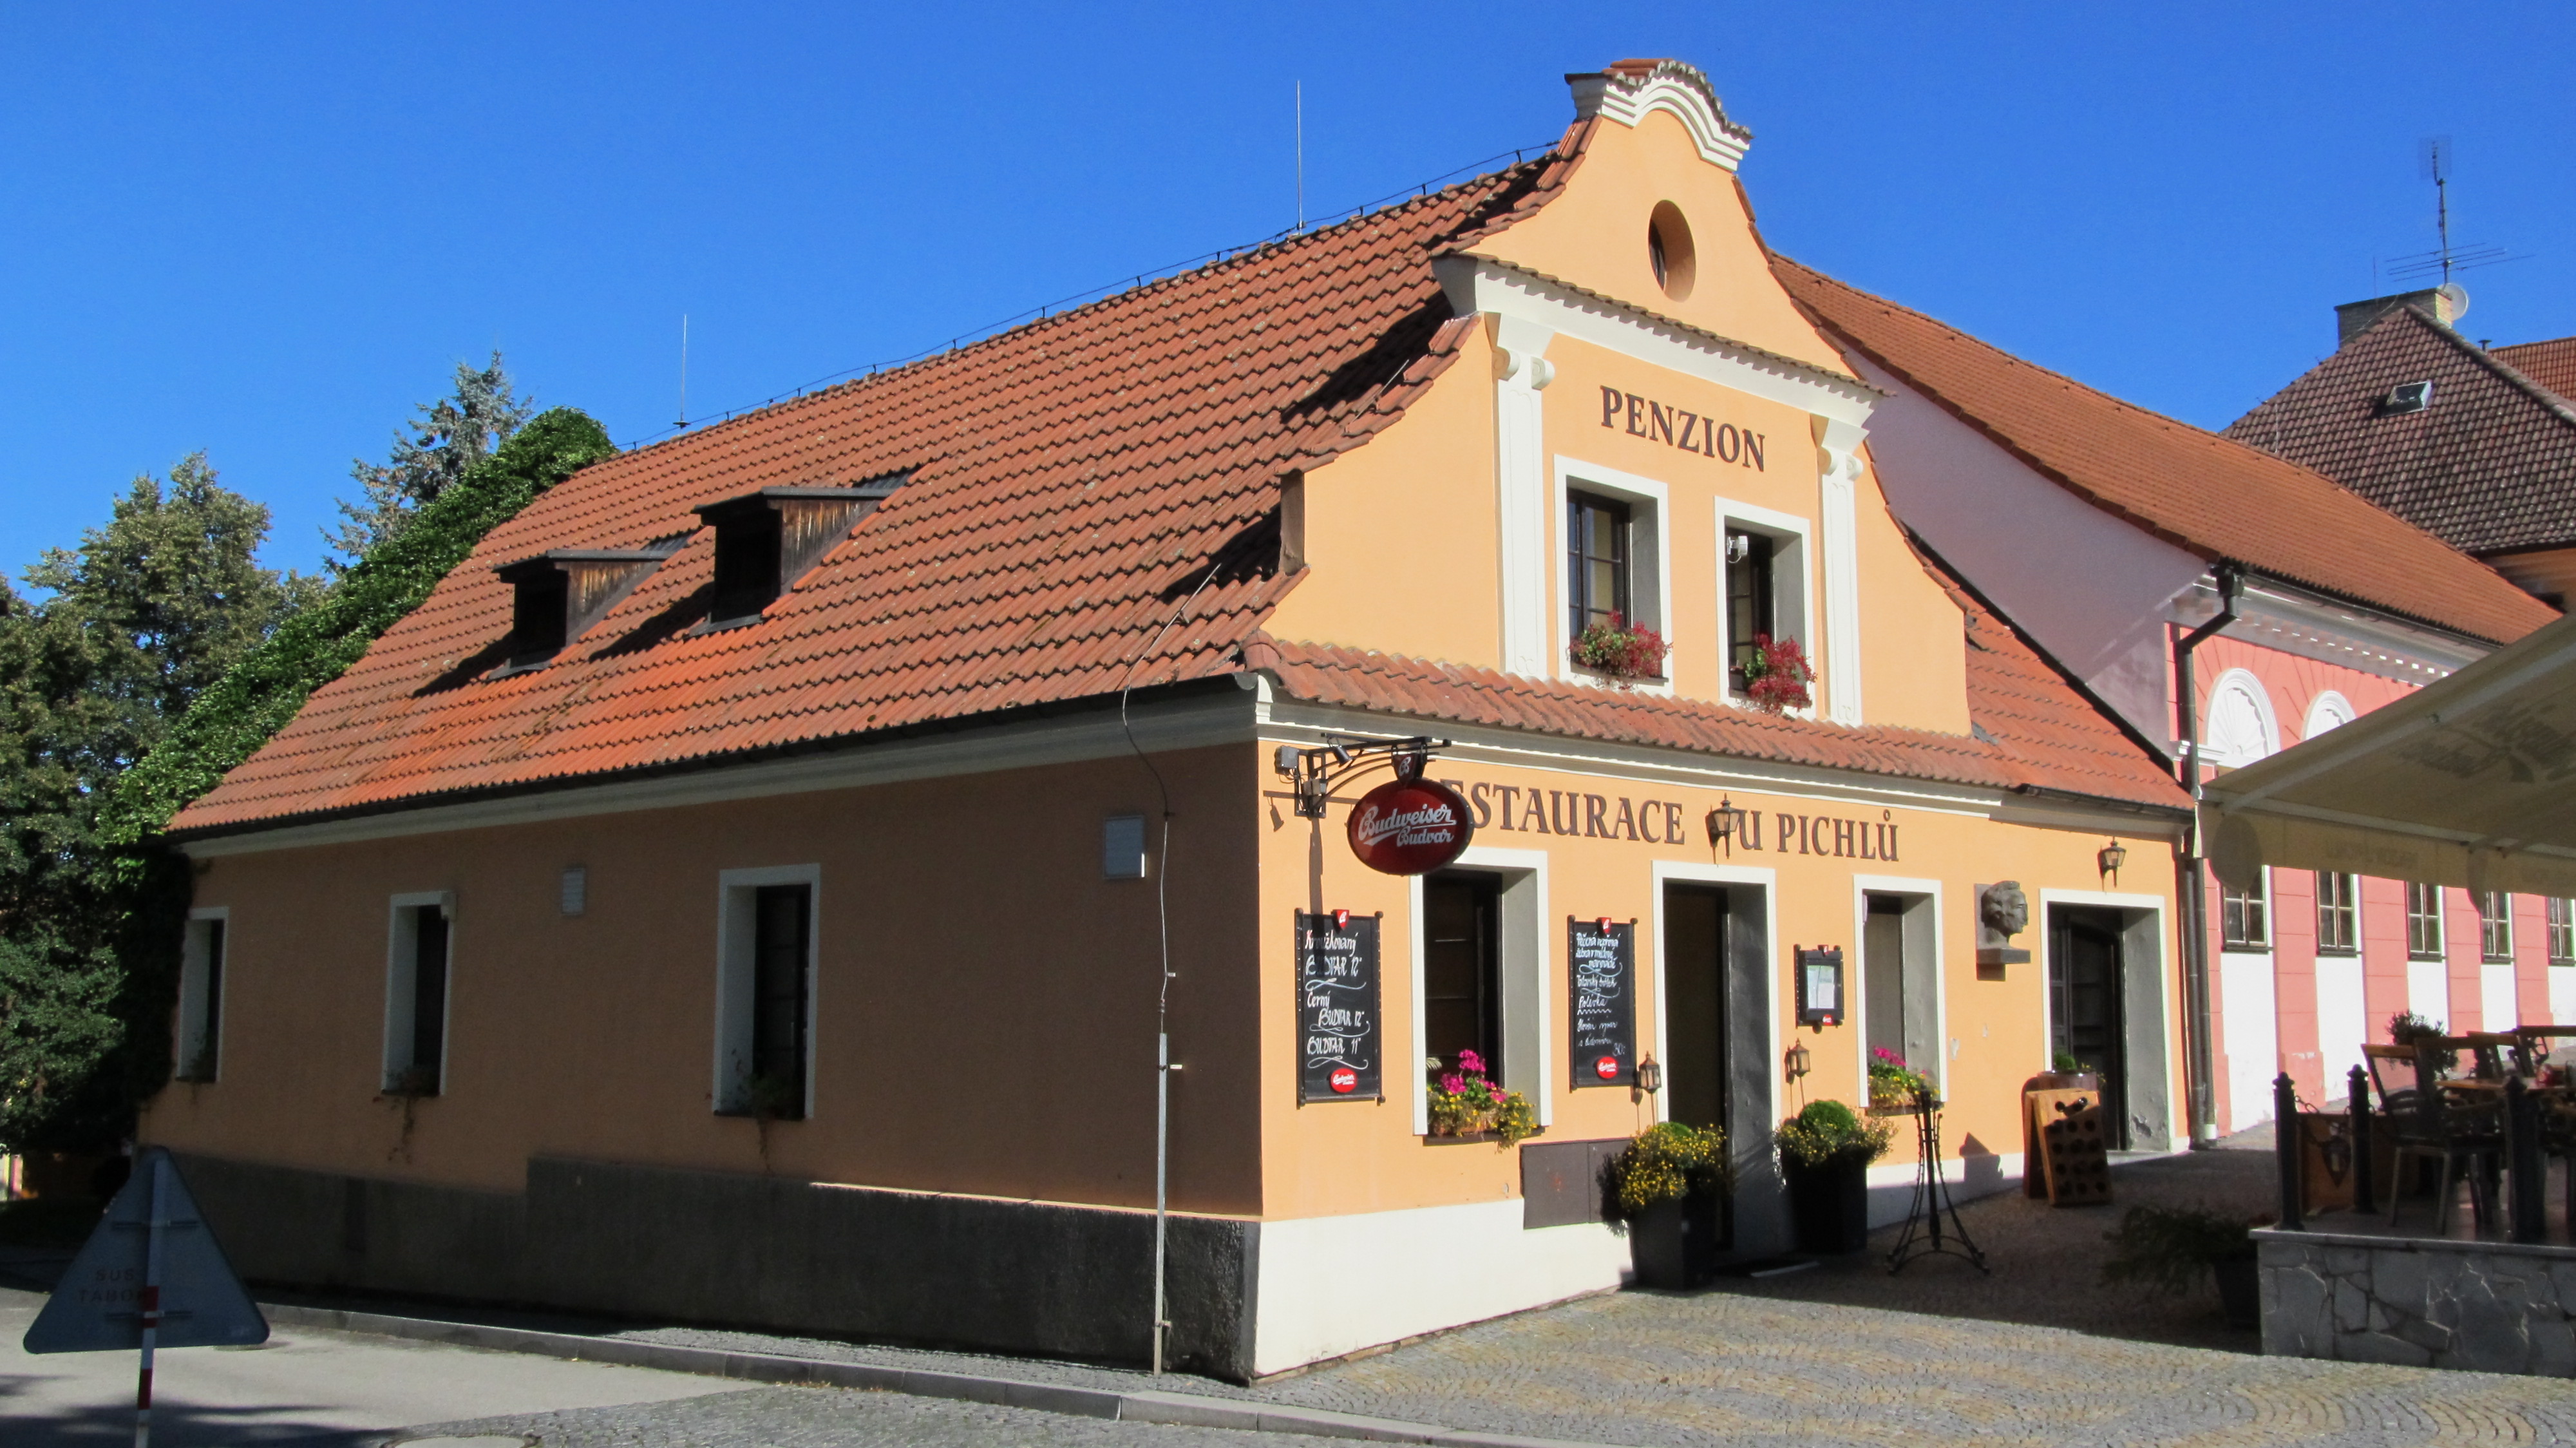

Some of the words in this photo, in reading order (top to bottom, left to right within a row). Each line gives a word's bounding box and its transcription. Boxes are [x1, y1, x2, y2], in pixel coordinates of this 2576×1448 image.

[1600, 385, 1765, 472] PENZION
[1358, 804, 1457, 841] Budweiser
[1396, 826, 1455, 847] Budvar
[1739, 809, 1763, 851] U
[1776, 809, 1899, 862] PICHLŮ
[1318, 1007, 1352, 1027] BUDVAR
[1307, 1036, 1346, 1055] BUDVAR
[95, 1268, 135, 1281] SUS
